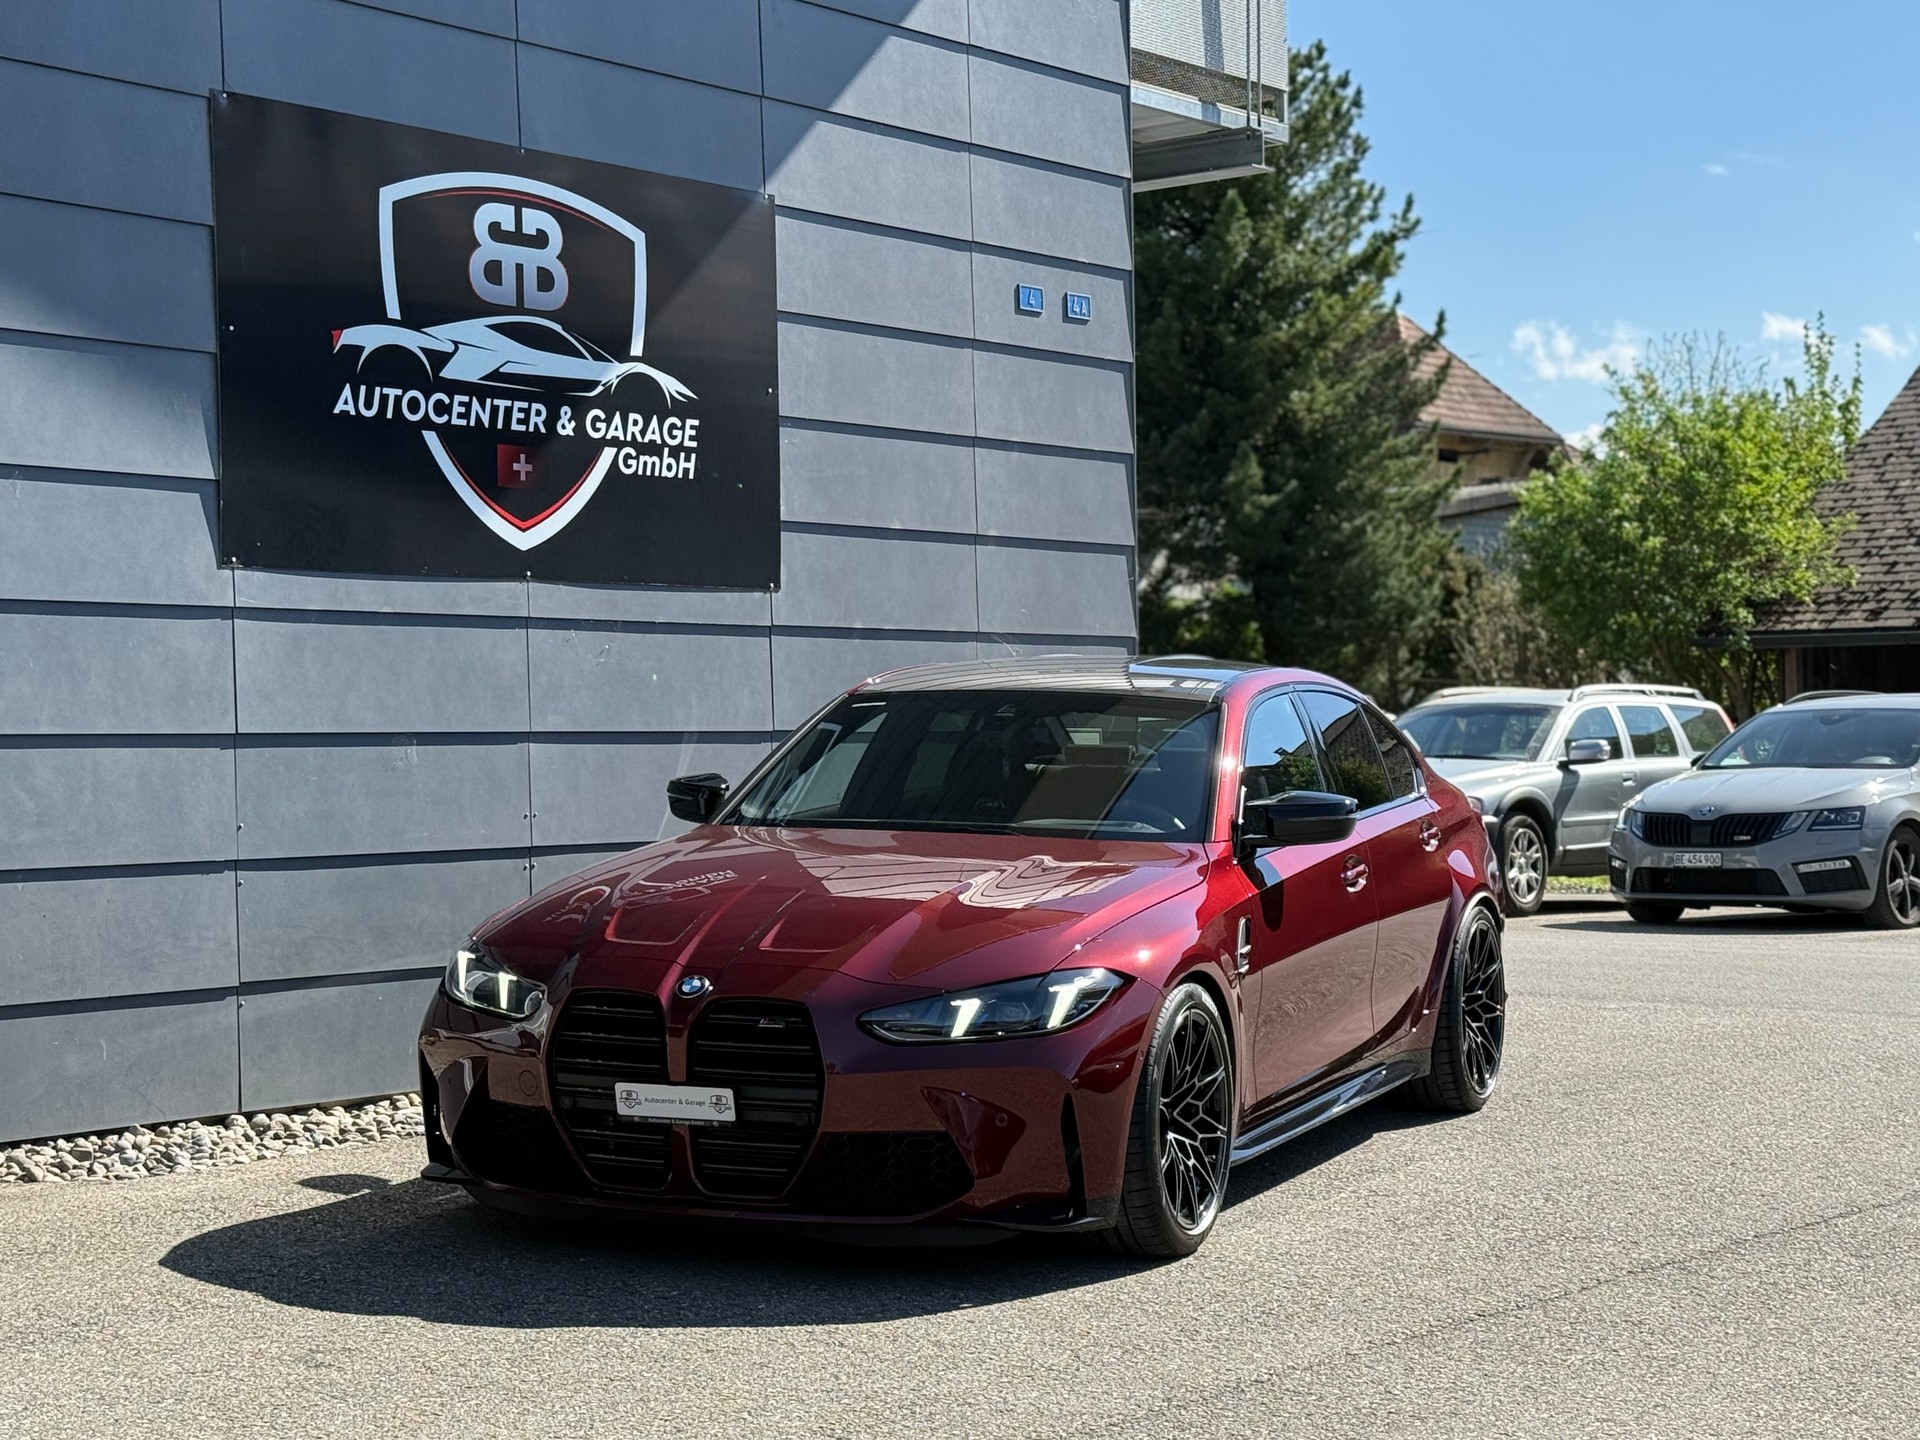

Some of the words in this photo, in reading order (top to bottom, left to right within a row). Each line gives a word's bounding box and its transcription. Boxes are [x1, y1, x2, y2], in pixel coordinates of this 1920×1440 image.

[1074, 297, 1087, 315] 4A
[333, 383, 547, 434] AUTOCENTER
[556, 407, 576, 436] &
[586, 409, 700, 448] GARAGE
[617, 448, 696, 480] GmbH
[1675, 854, 1686, 864] BE
[644, 1097, 677, 1105] Autocenter
[685, 1098, 706, 1107] Garage
